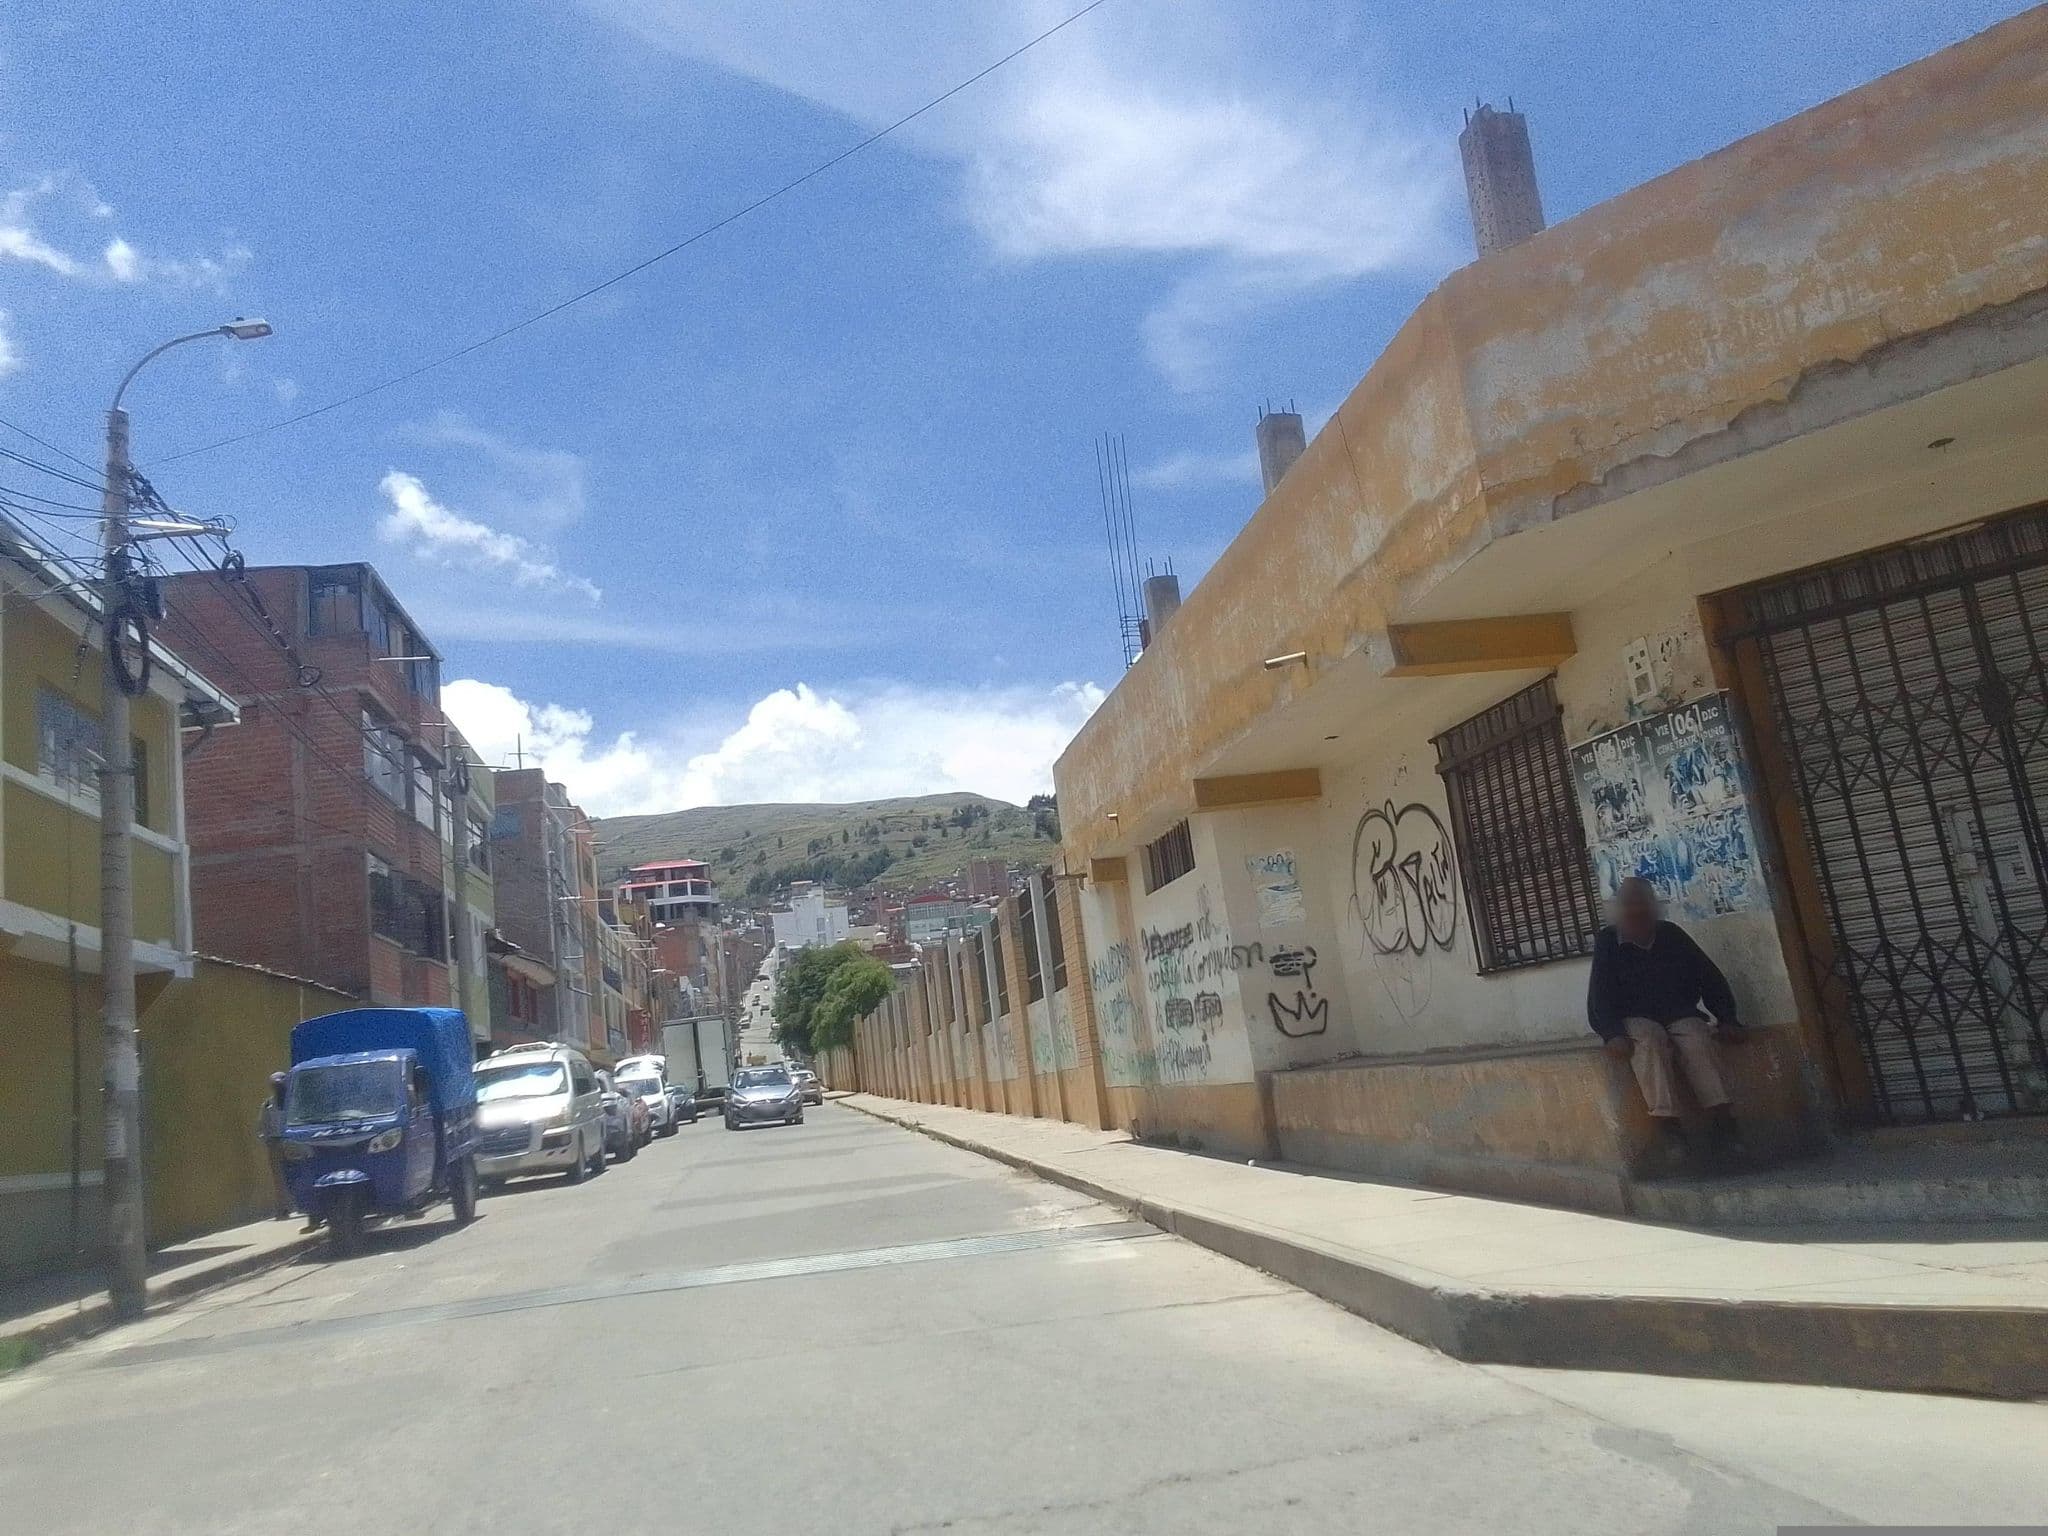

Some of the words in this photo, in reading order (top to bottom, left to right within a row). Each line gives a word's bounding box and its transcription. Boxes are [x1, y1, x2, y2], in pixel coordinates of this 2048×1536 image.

[1655, 724, 1670, 738] VIE
[1701, 706, 1719, 721] DIC
[1581, 752, 1594, 765] VIE
[1621, 736, 1636, 750] DIC
[1674, 734, 1699, 751] TEATR
